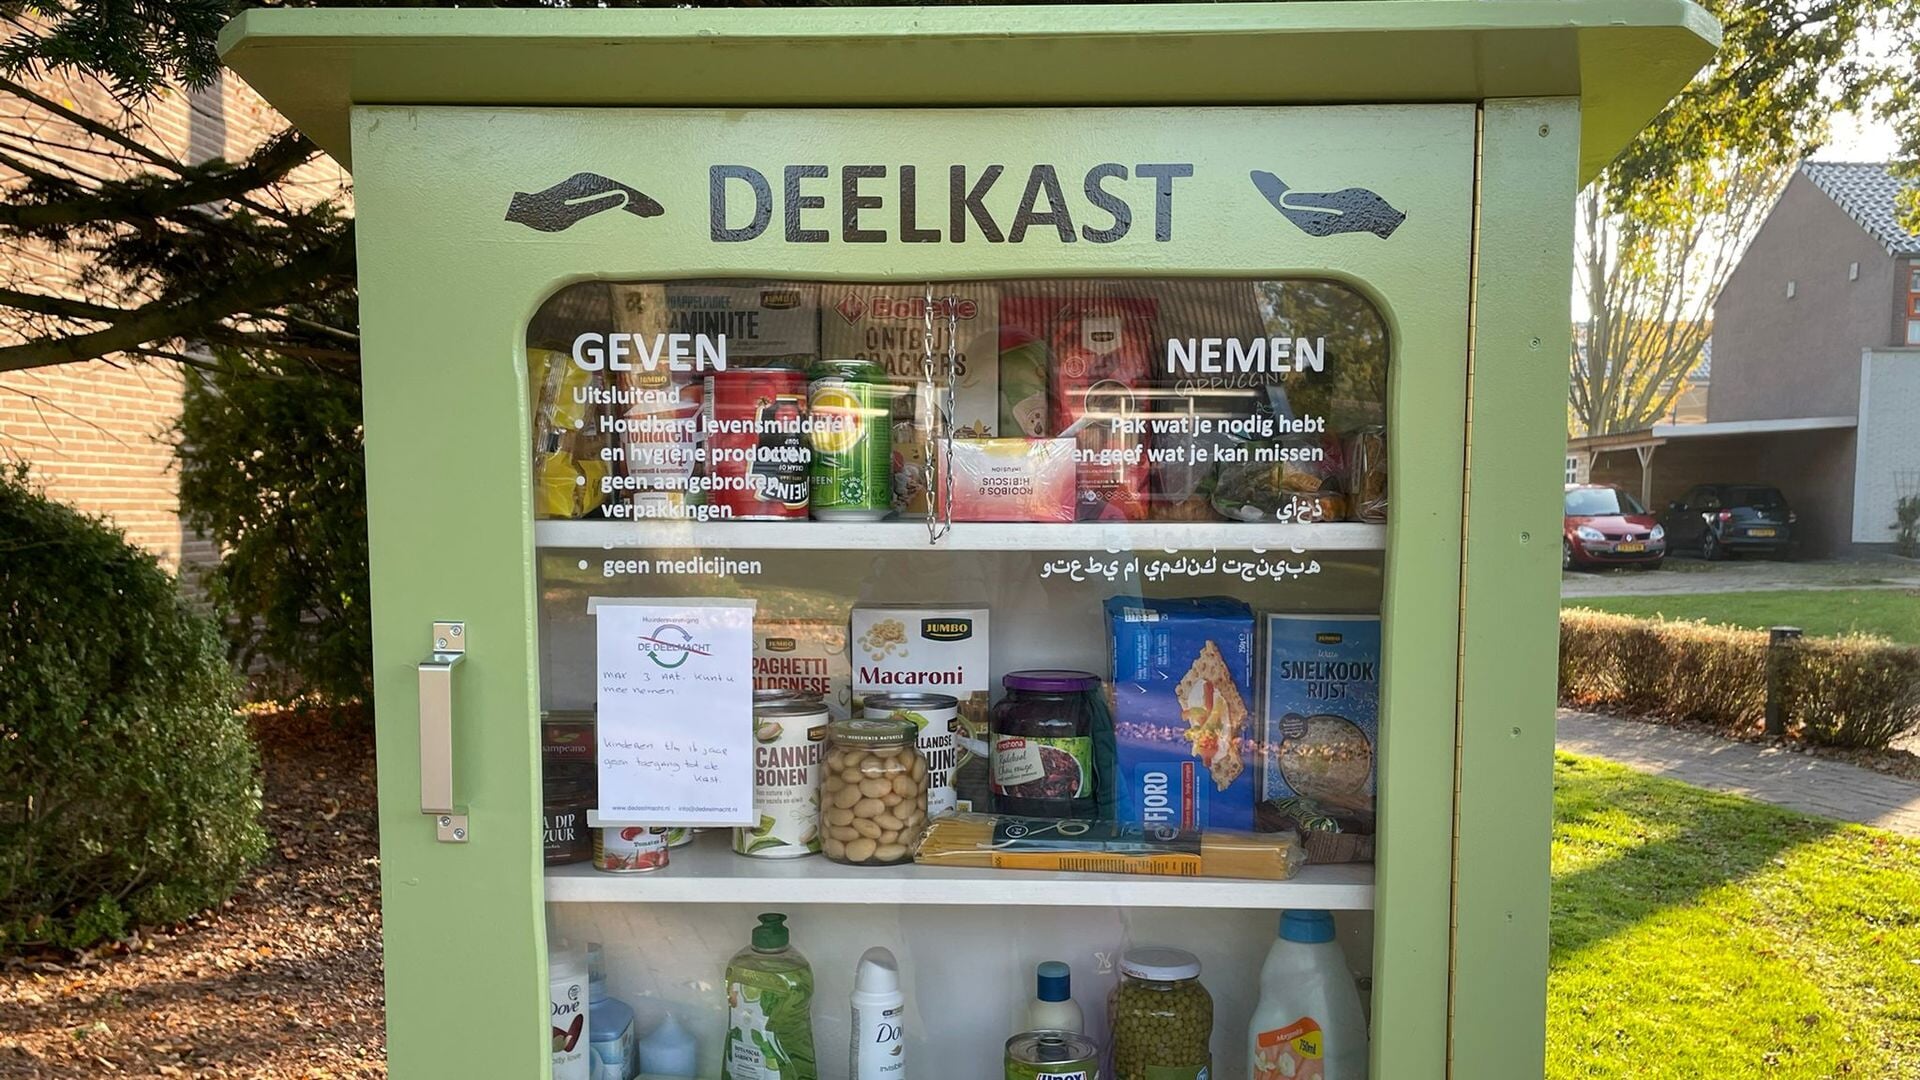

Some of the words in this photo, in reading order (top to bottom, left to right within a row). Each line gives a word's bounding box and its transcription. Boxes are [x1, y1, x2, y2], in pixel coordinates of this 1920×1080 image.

[709, 163, 1194, 243] DEELKAST
[866, 327, 954, 350] ONTBJT
[572, 332, 727, 372] GEVEN
[1167, 337, 1325, 374] NEMEN
[1174, 372, 1289, 397] CAPPUCCINO
[573, 385, 680, 405] Uitsluitend
[600, 415, 696, 433] Houdbare
[702, 413, 857, 434] levensmiddelen
[1112, 414, 1147, 434] Pak
[1151, 418, 1189, 434] wat
[1193, 414, 1212, 438] je
[1218, 414, 1273, 438] nodig
[1279, 414, 1325, 434] hebt
[600, 447, 624, 462] en
[631, 443, 706, 466] hygiëne
[712, 443, 811, 466] producten
[1071, 448, 1094, 463] en
[1100, 443, 1143, 466] geef
[1148, 447, 1186, 462] wat
[1189, 444, 1209, 466] je
[1213, 443, 1249, 462] kan
[1255, 443, 1324, 462] missen
[600, 476, 648, 493] geen
[653, 472, 780, 493] aangebroken
[811, 476, 833, 485] REEN
[982, 477, 1030, 486] HIBISCUS
[987, 487, 1033, 496] ROOIBOS
[602, 502, 733, 522] verpakkingen
[603, 560, 650, 576] geen
[656, 557, 762, 577] medicijnen
[926, 623, 968, 634] JUMBO
[637, 643, 651, 652] DE
[653, 642, 711, 652] DEELMACHT
[752, 657, 828, 675] PAGHETTI
[859, 666, 963, 685] Macaroni
[1281, 660, 1374, 680] SNELKOOK
[752, 677, 831, 694] LOGNESE
[1308, 682, 1348, 700] RIJST
[916, 734, 952, 749] LLANDSE
[926, 748, 955, 771] UINE
[755, 768, 807, 787] BONEN
[555, 813, 576, 829] DIP
[551, 1000, 580, 1016] Dove
[876, 1022, 903, 1043] Do
[1299, 1039, 1317, 1055] 750ml
